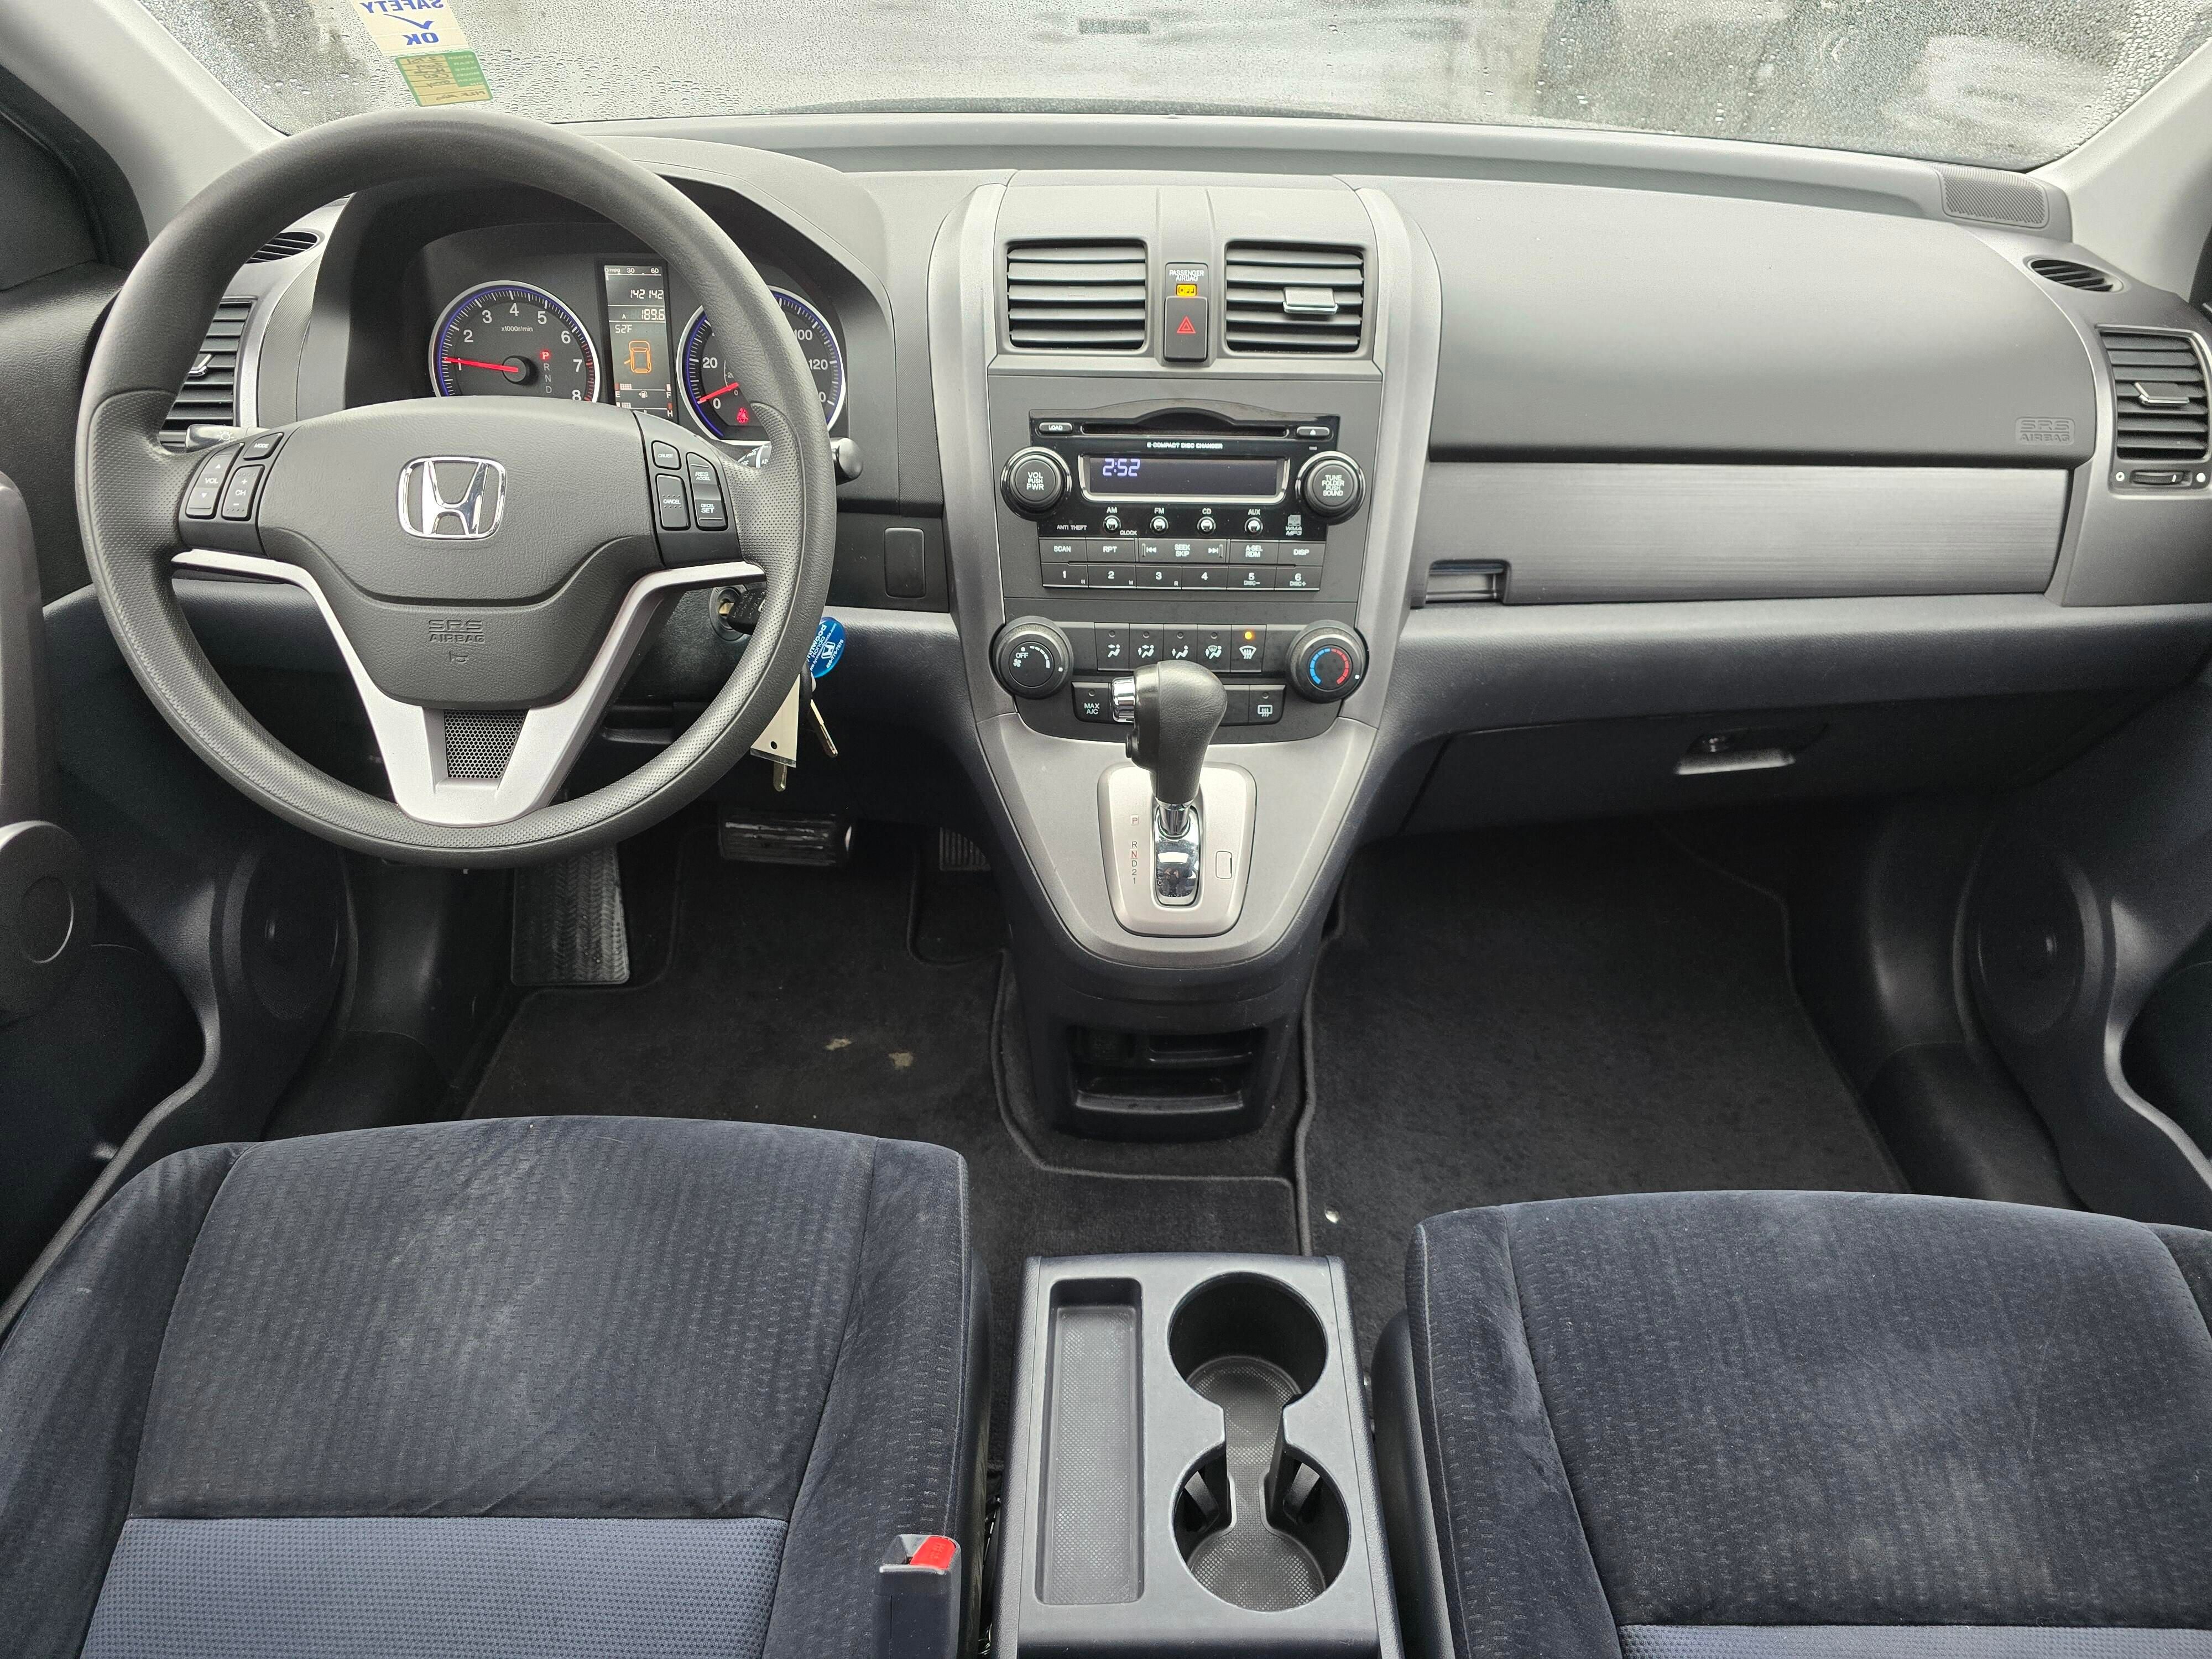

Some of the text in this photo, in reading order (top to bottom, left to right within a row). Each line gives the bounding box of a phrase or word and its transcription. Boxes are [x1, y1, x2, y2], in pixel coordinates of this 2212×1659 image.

[509, 302, 519, 316] 4
[641, 309, 665, 321] 189.6
[482, 310, 492, 324] 3
[538, 311, 547, 324] 5
[463, 329, 474, 343] 2
[561, 330, 571, 344] 6
[794, 329, 813, 341] 100
[541, 351, 550, 360] P
[544, 363, 550, 371] R
[573, 359, 583, 372] 7
[702, 357, 718, 369] 20
[808, 359, 828, 371] 120
[545, 374, 552, 383] N
[572, 389, 582, 401] 8
[713, 398, 721, 409] 0
[2021, 419, 2070, 431] SRS
[2020, 433, 2070, 442] AIRBAG
[1102, 457, 1141, 477] 2:52
[1062, 570, 1067, 579] 1
[1108, 571, 1115, 579] 2
[1155, 571, 1162, 580] 3
[1201, 572, 1208, 581] 4
[1248, 572, 1255, 581] 5
[1295, 573, 1302, 581] 6
[429, 619, 483, 632] SRS
[429, 634, 486, 644] AIRBAG
[811, 636, 826, 658] Honda
